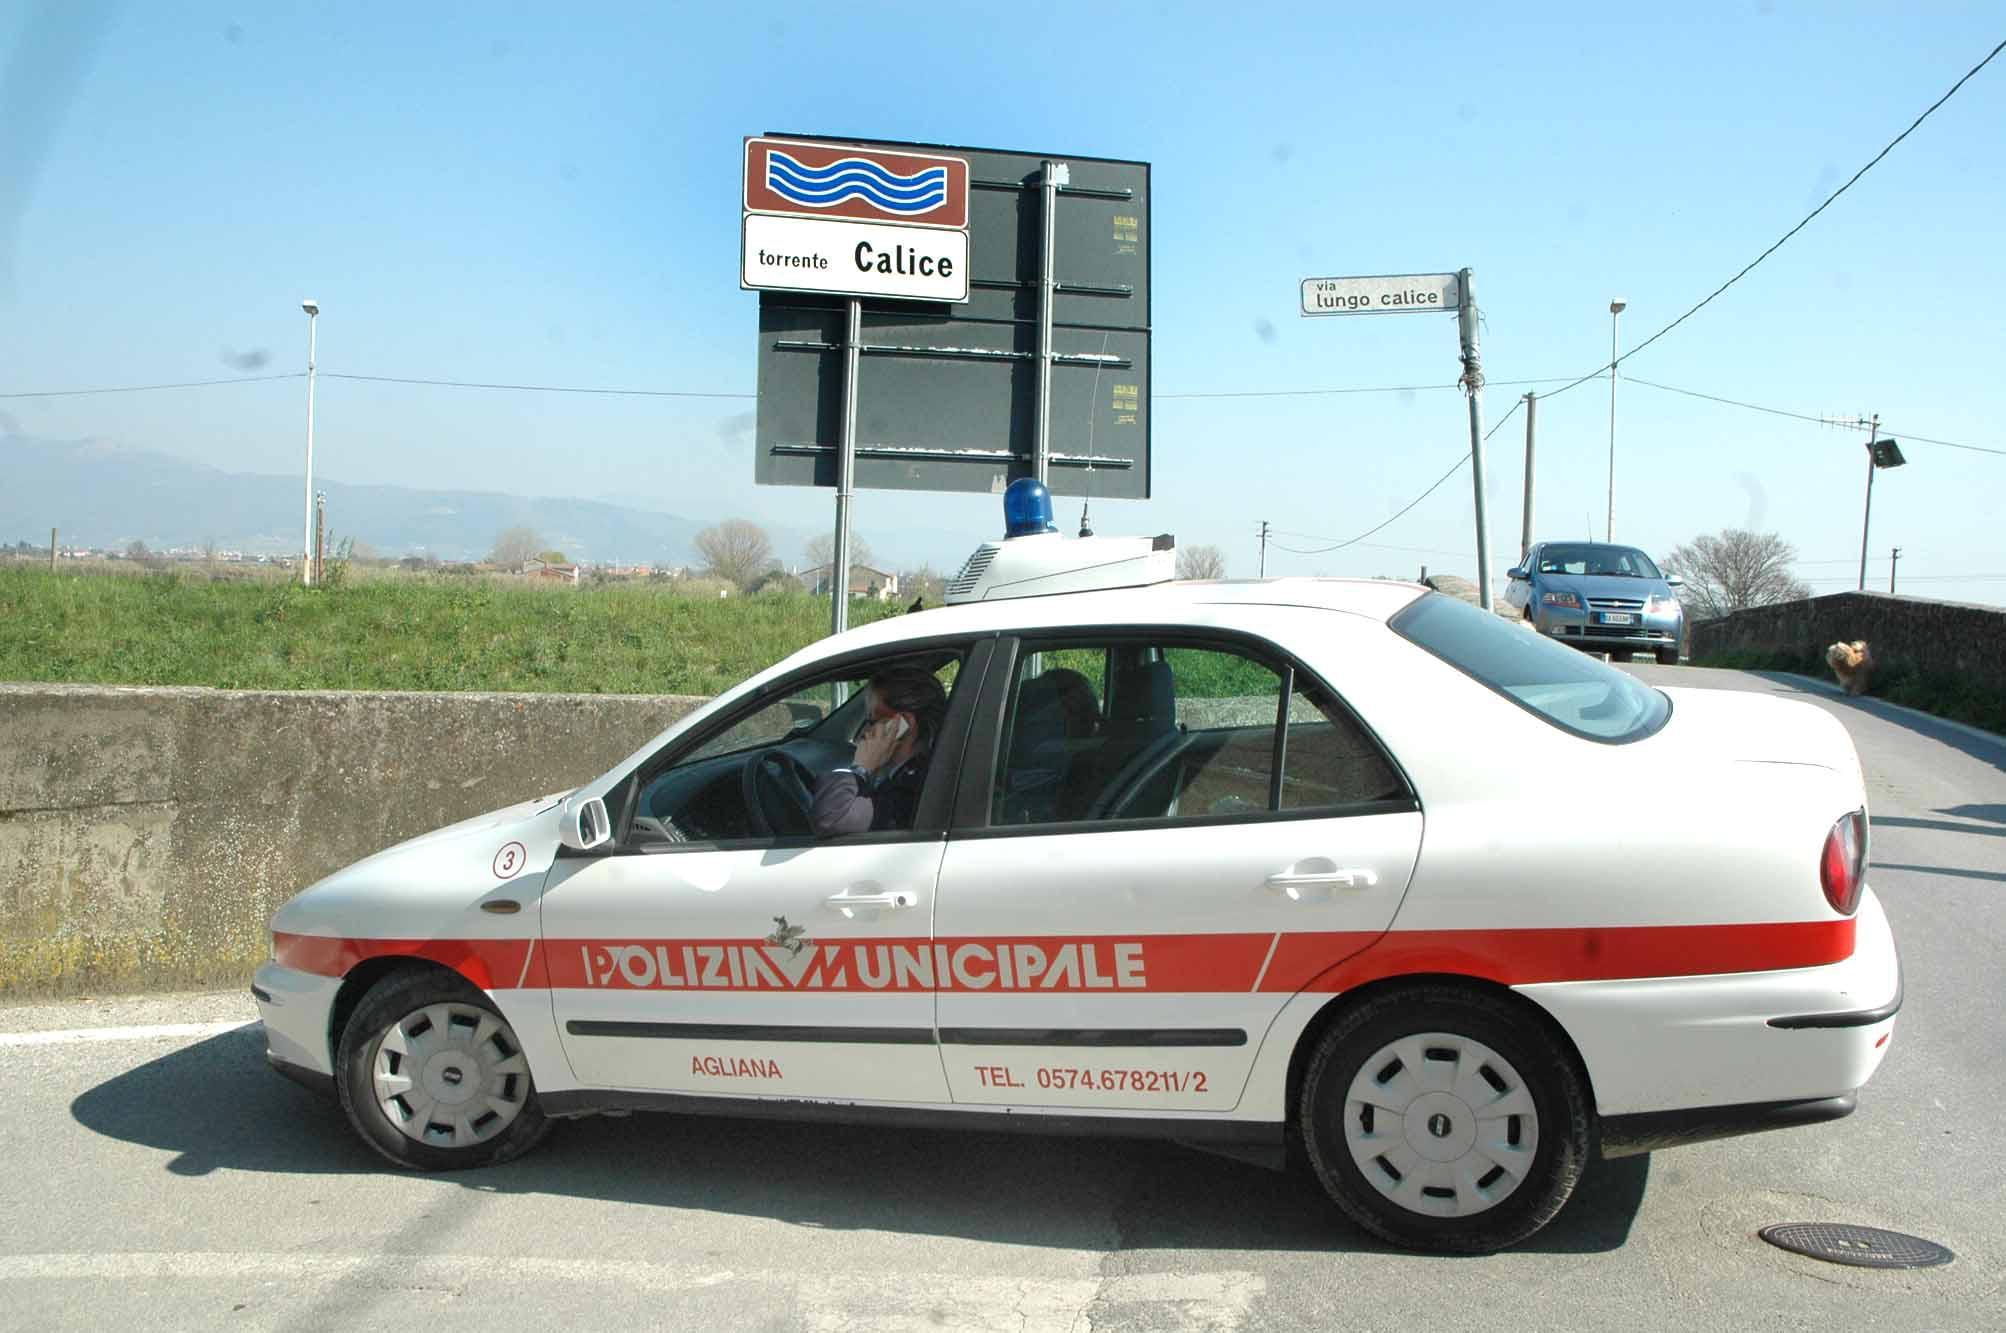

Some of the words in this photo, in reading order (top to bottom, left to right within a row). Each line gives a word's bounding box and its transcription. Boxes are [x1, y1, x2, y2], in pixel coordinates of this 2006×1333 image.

[758, 249, 828, 270] torrente
[854, 241, 953, 278] Calice
[1316, 281, 1337, 292] via
[1316, 293, 1370, 309] lungo
[1380, 290, 1438, 306] calice
[503, 850, 515, 870] 3
[581, 944, 787, 988] POLIZIA
[800, 943, 1147, 989] MUNICIPALE
[691, 1055, 783, 1079] AGLIANA
[974, 1066, 1025, 1087] TEL.
[1036, 1067, 1208, 1093] 0574.678211/2
